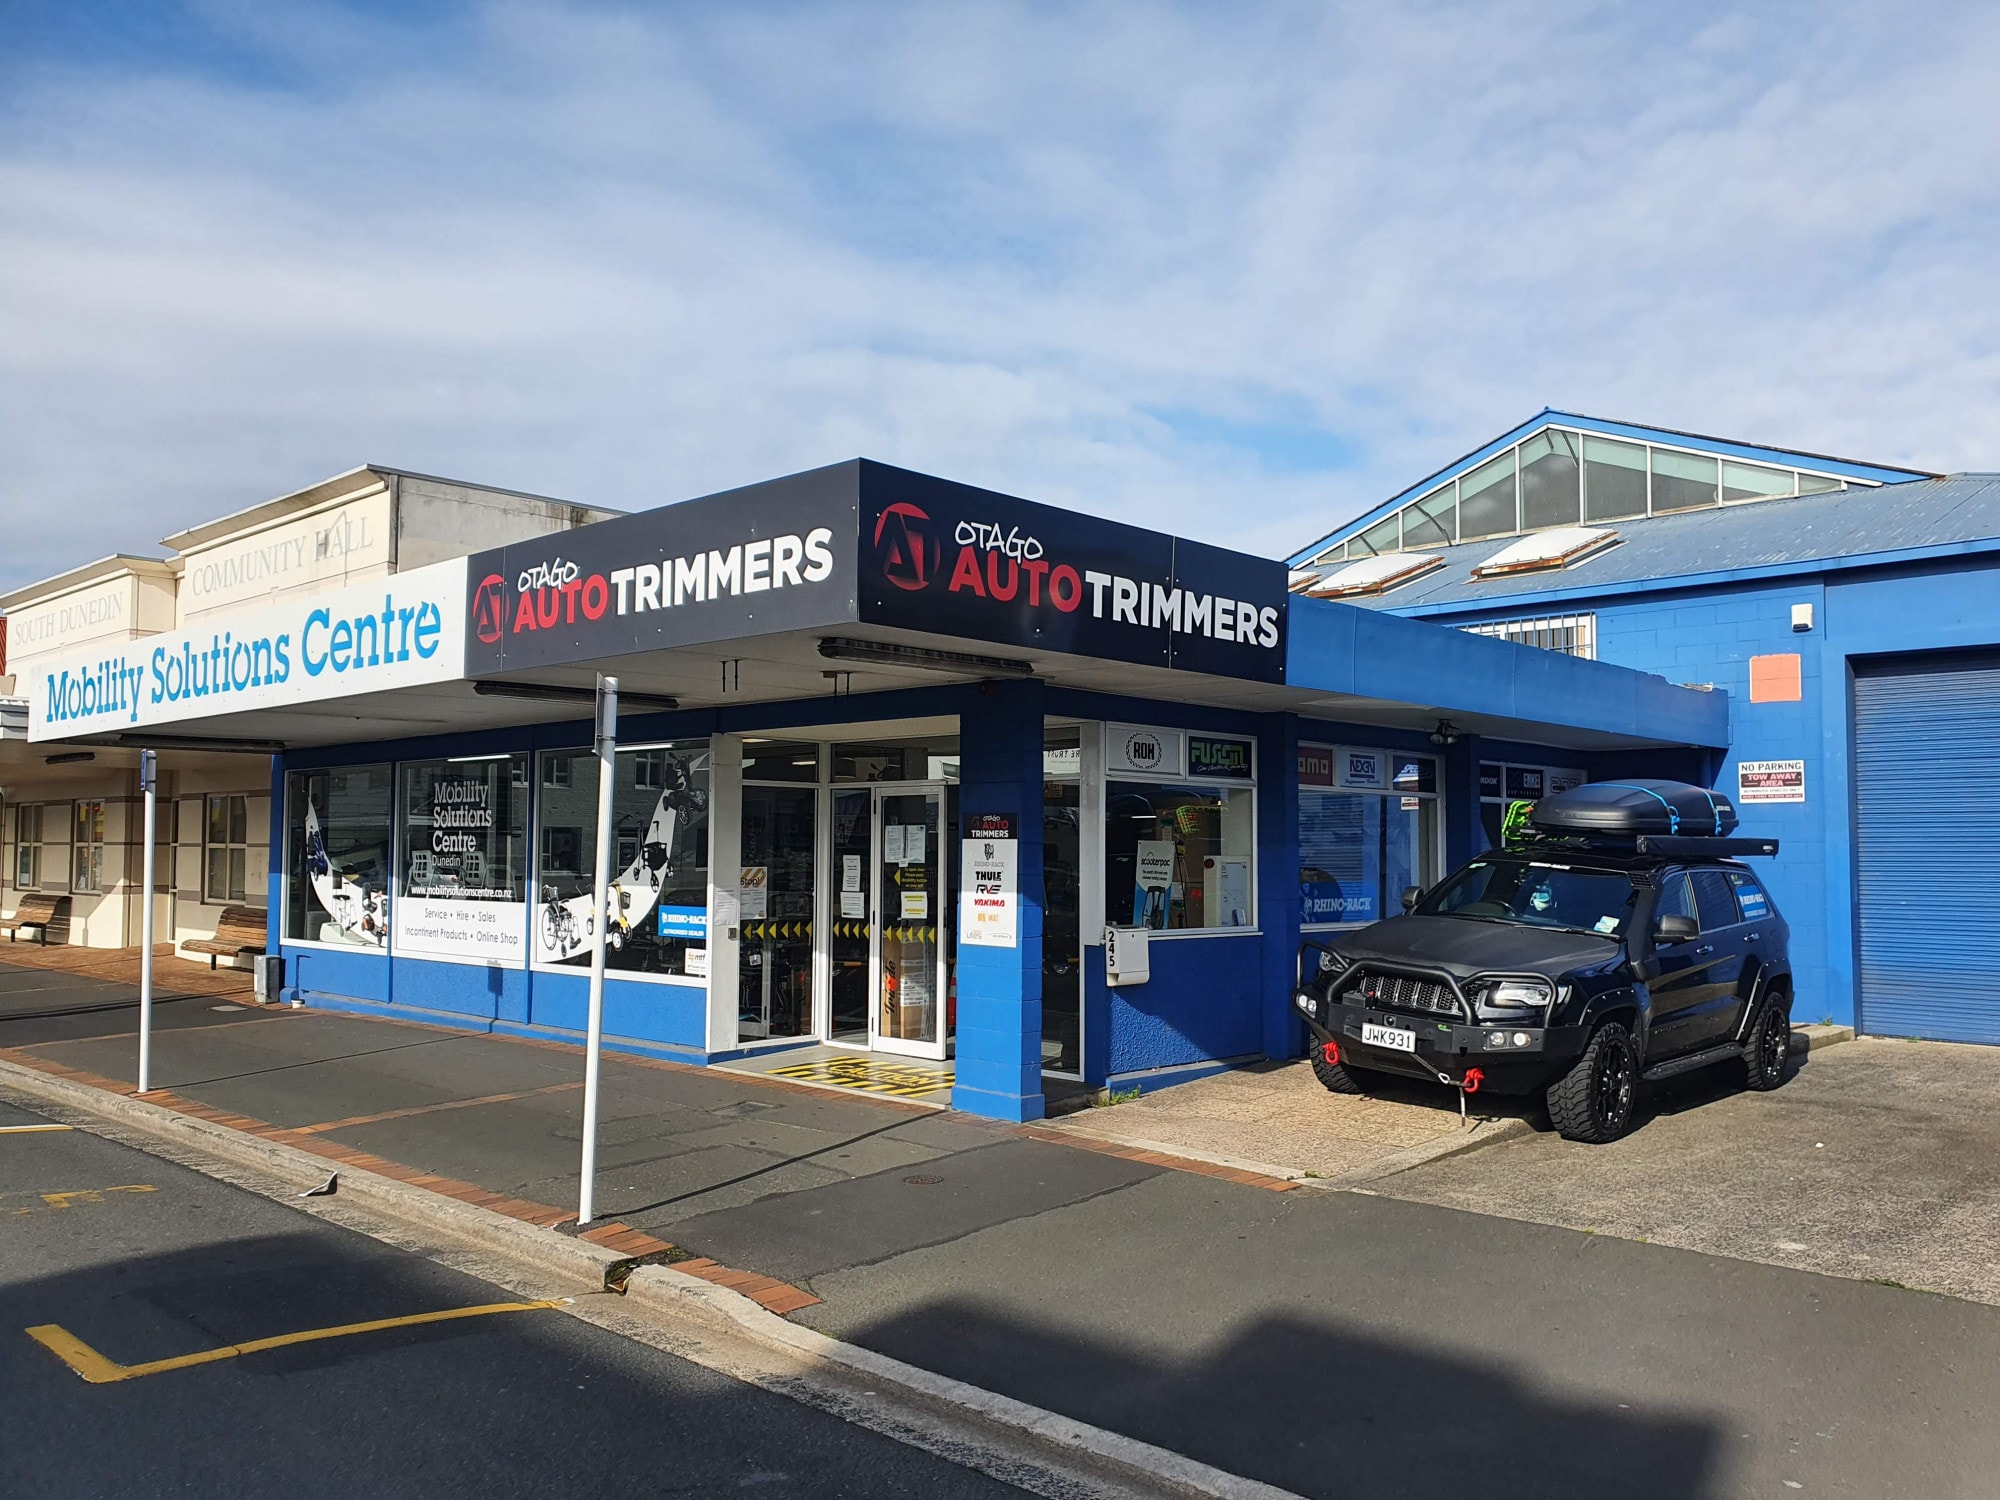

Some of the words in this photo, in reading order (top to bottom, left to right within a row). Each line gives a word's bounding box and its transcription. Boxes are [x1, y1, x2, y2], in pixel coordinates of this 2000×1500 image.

[955, 520, 1043, 564] OTAGO
[192, 535, 307, 596] COMMUNITY
[314, 516, 374, 561] HALL
[513, 575, 608, 634] AUTO
[610, 527, 833, 616] TRIMMERS
[517, 557, 579, 593] OTAGO
[948, 545, 1081, 613] AUTO
[1085, 570, 1279, 648] TRIMMERS
[15, 612, 55, 647] SOUTH
[60, 591, 124, 634] DUNEDIN
[46, 657, 144, 722] Mobility
[151, 631, 290, 705] Solutions
[301, 594, 442, 677] Centre
[1134, 742, 1154, 760] ROH
[1741, 763, 1754, 771] NO
[1758, 762, 1801, 771] PARKING
[1770, 772, 1797, 780] AWAY
[434, 780, 488, 807] Mobility
[433, 805, 492, 828] Solutions
[982, 820, 1009, 829] AUTO
[432, 830, 477, 852] Centre
[971, 829, 1009, 838] TRIMMERS
[432, 853, 461, 867] Dunedin
[740, 877, 760, 888] Stop!
[975, 871, 1002, 881] THULE
[411, 884, 512, 898] www.mobilitysolutionscentre.co.nz
[974, 899, 1005, 907] YAKIMA
[1313, 897, 1372, 913] RHINO-RACK
[424, 908, 448, 920] Service
[456, 909, 469, 921] Hire
[478, 911, 496, 923] Sales
[404, 926, 439, 939] Incontinent
[440, 928, 468, 941] Products
[476, 930, 499, 943] Online
[500, 932, 518, 946] Shop
[1364, 1028, 1411, 1049] JWK931
